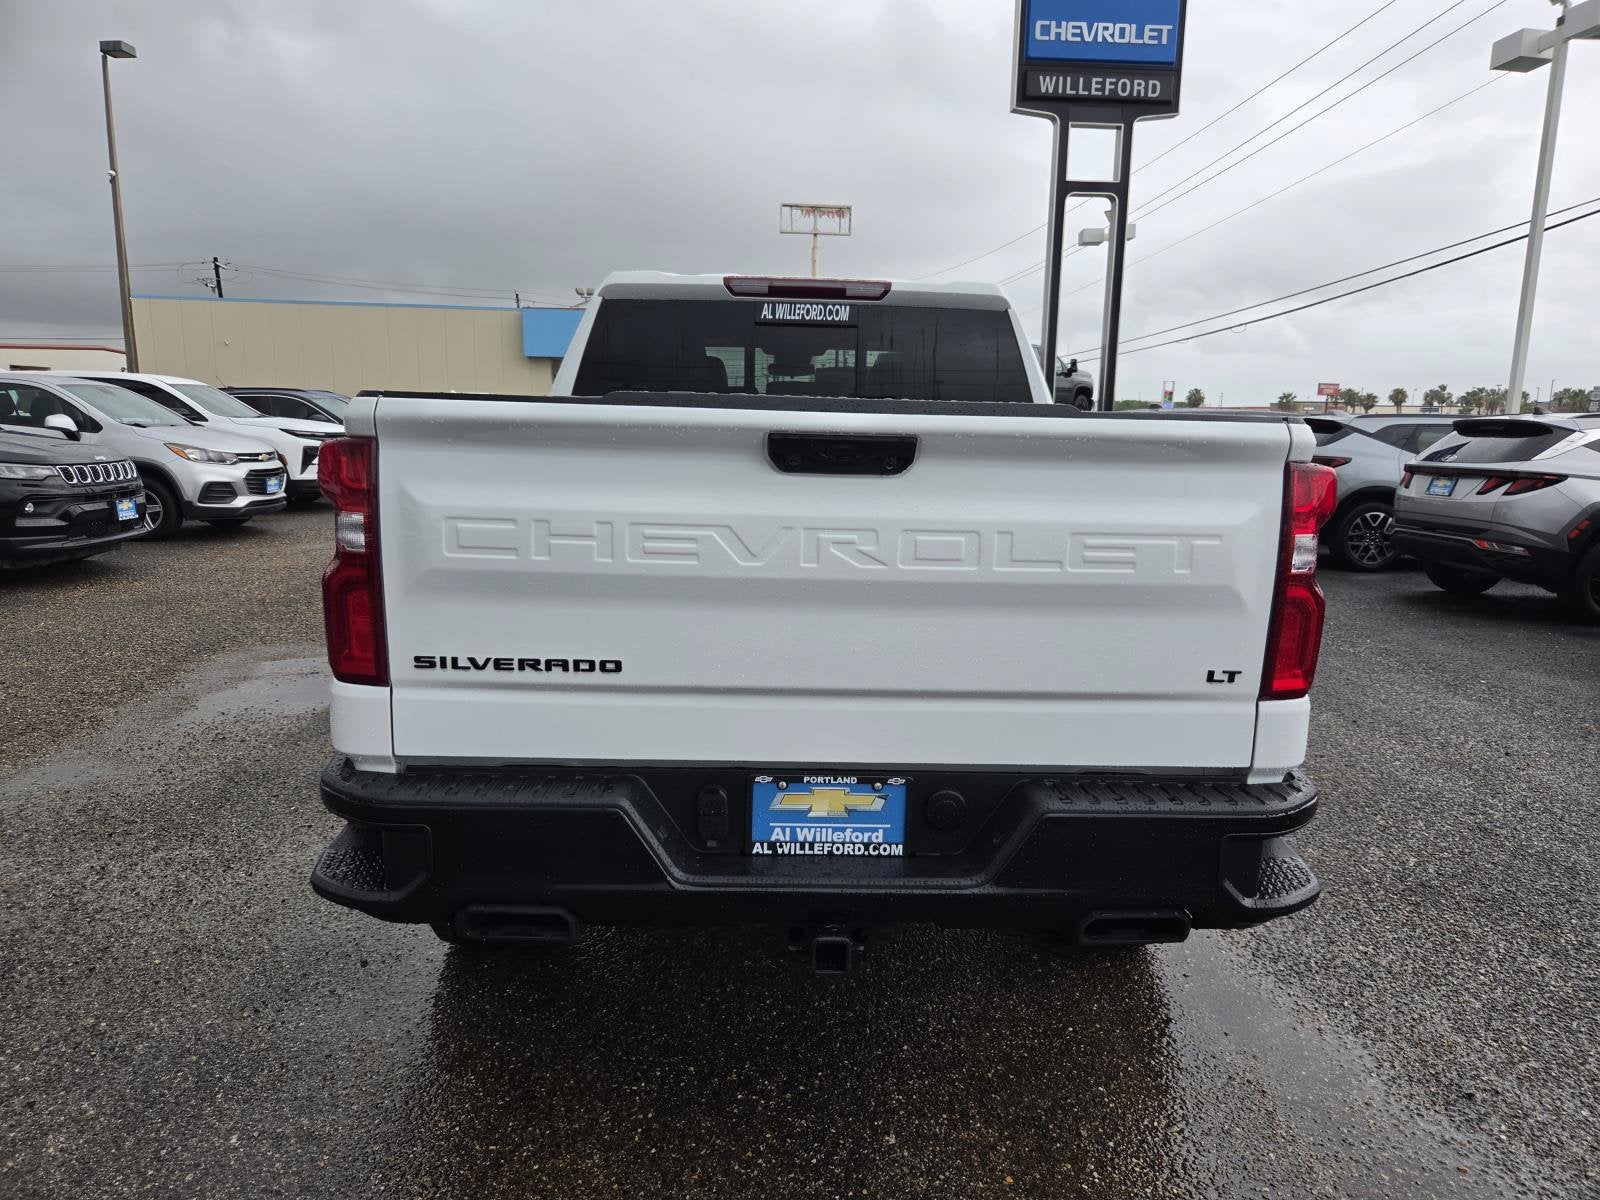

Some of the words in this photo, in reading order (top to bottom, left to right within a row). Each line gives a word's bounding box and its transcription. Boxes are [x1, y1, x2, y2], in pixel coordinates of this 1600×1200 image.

[1035, 20, 1172, 45] CHEVROLET
[1039, 75, 1161, 97] WILLEFORD
[761, 303, 773, 319] AL
[776, 303, 850, 321] WILLEFORD.COM
[441, 516, 1222, 574] CHEVROLET
[413, 654, 623, 673] SILVERADO
[1205, 668, 1242, 684] LT
[803, 776, 858, 784] PORTLAND
[770, 827, 791, 842] Al
[796, 827, 884, 843] Willeford
[752, 842, 772, 855] AL
[776, 842, 903, 856] WILLEFORD.COM
